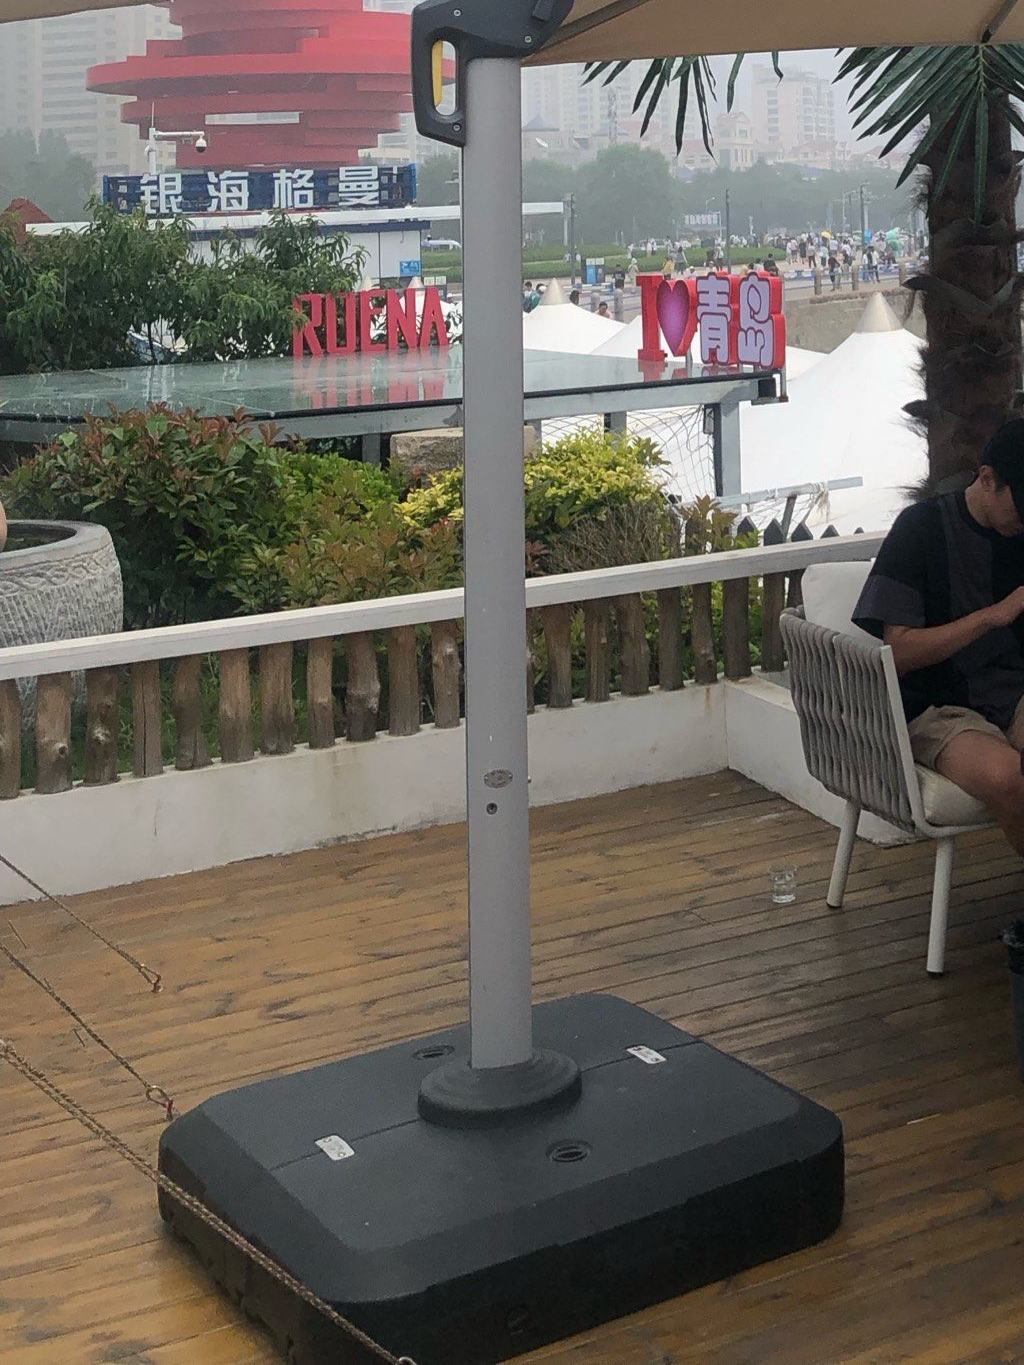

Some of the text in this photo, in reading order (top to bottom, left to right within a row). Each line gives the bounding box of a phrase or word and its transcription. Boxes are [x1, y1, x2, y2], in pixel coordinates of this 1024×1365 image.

[140, 166, 379, 214] 银海格曼
[696, 271, 784, 369] 青岛
